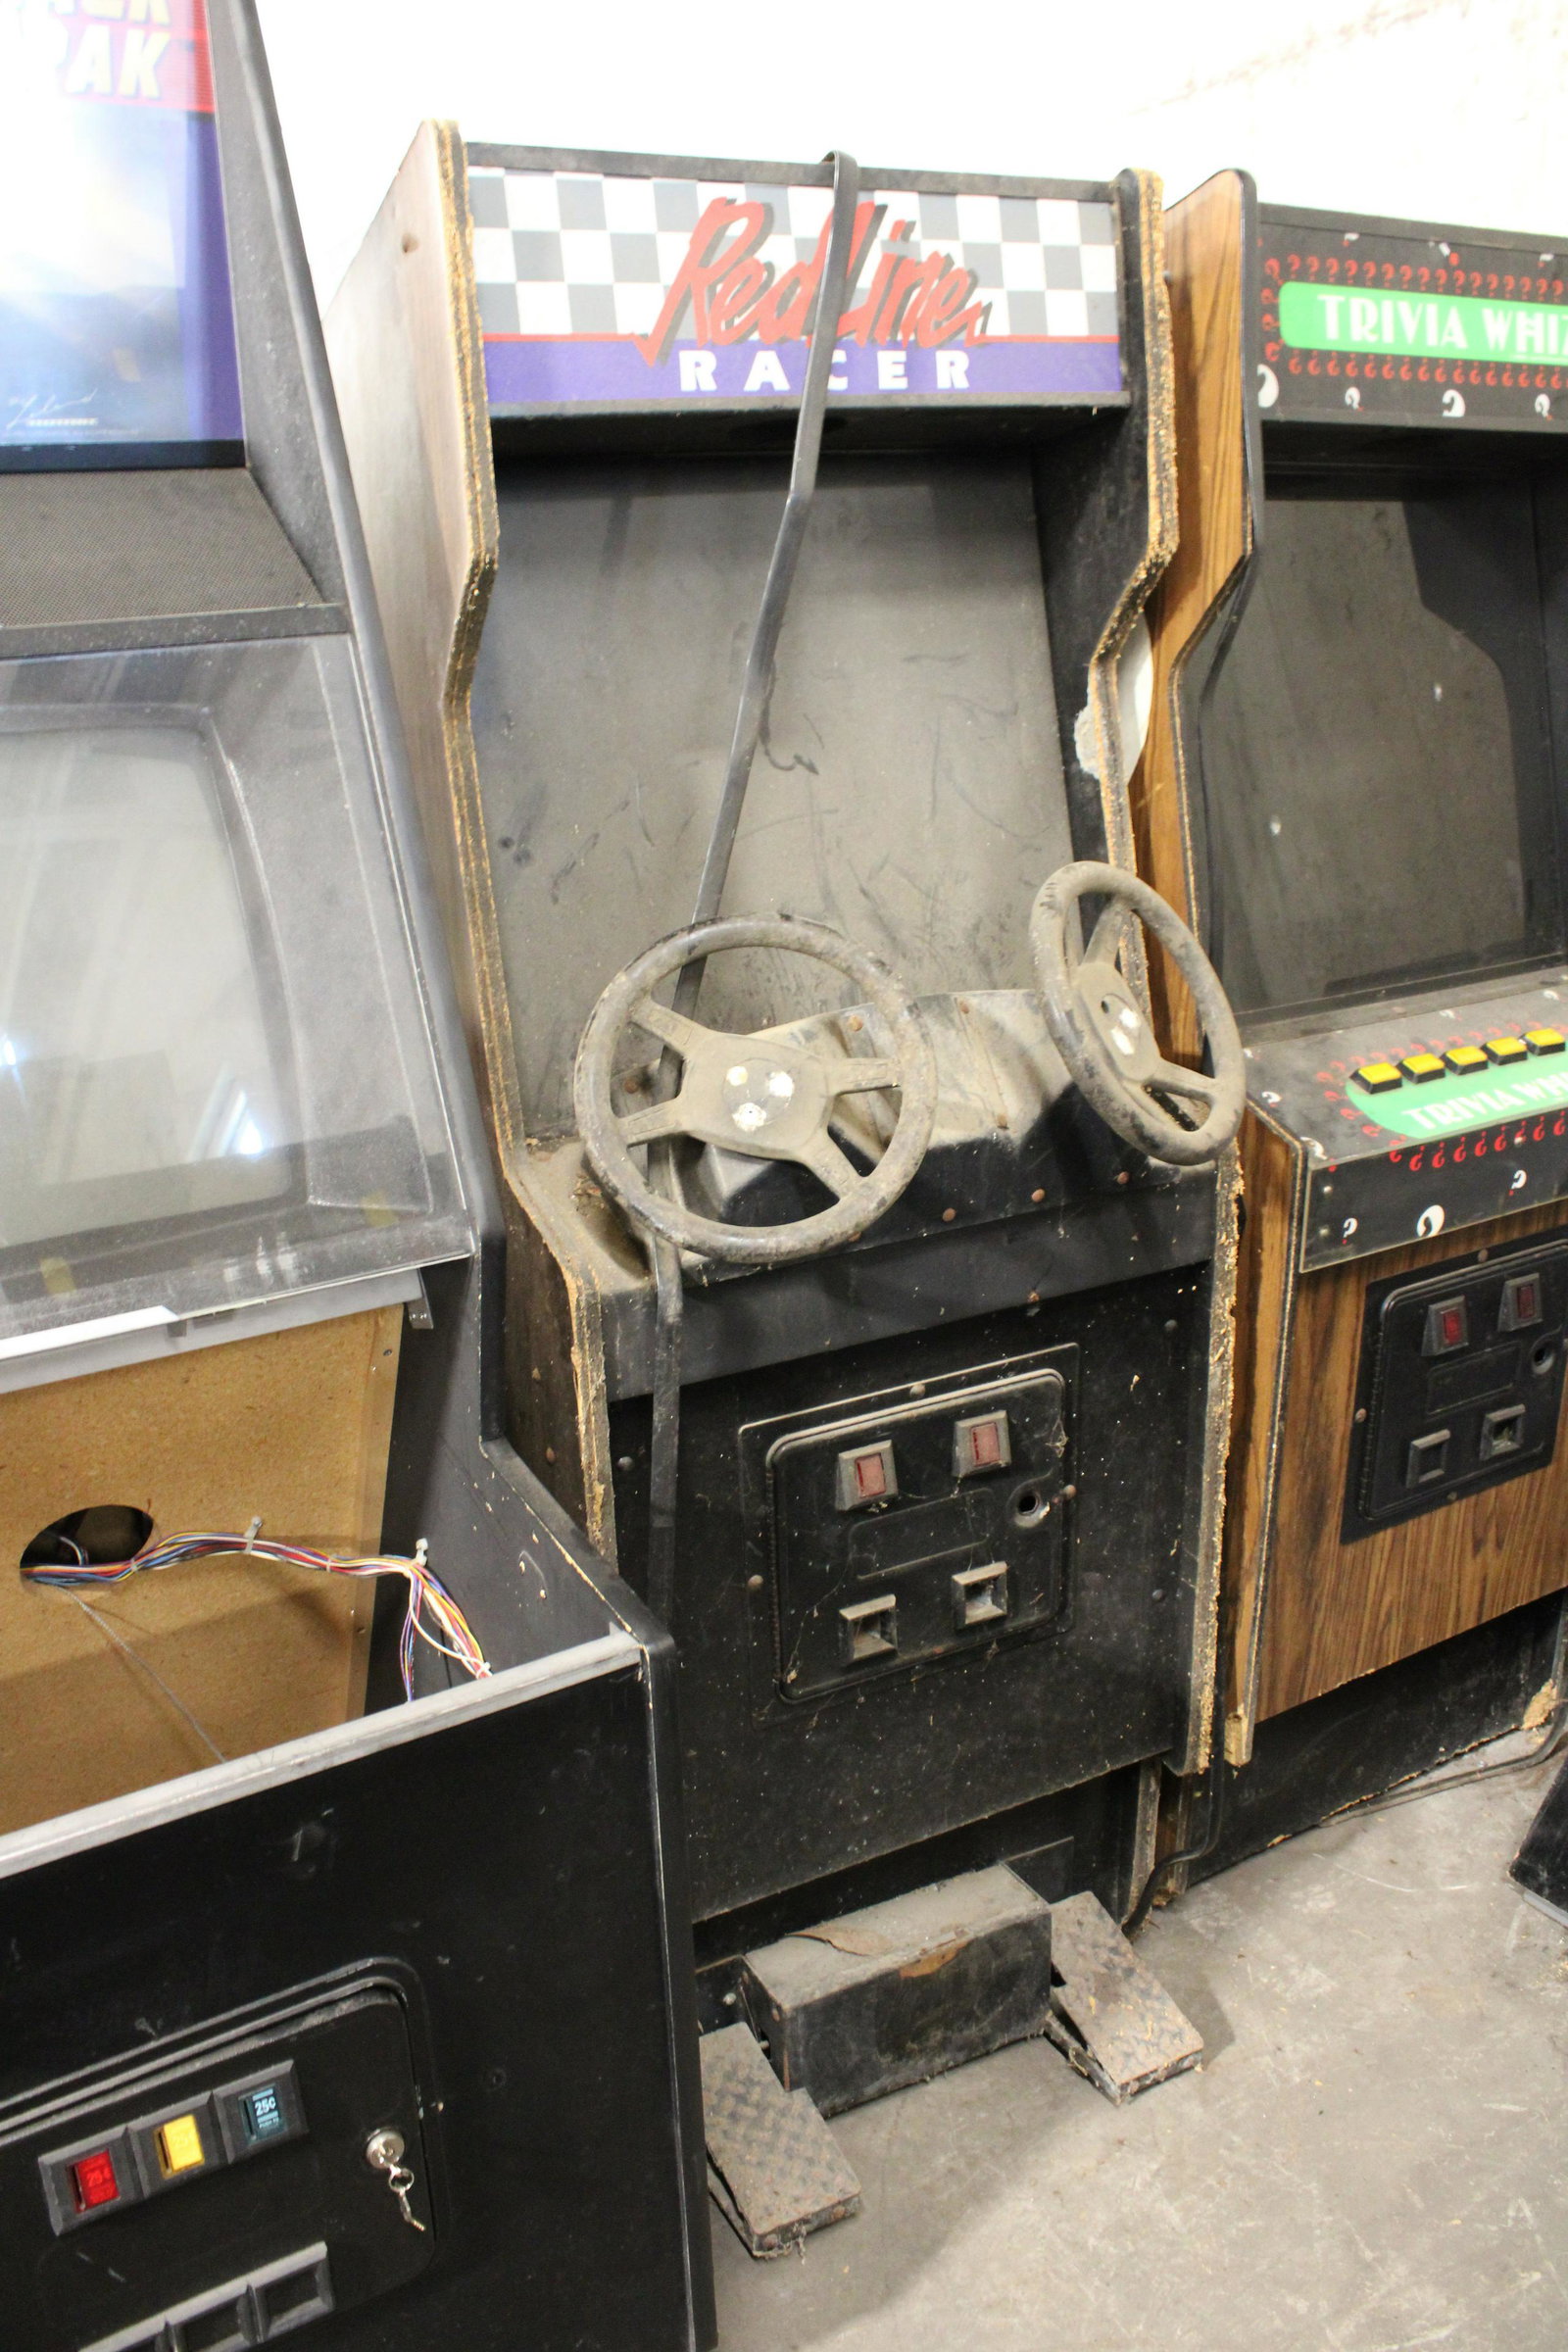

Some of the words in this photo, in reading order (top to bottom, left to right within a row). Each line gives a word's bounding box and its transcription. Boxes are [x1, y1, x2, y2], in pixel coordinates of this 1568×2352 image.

[1317, 294, 1468, 349] TRIVIA
[1481, 308, 1568, 356] WHI
[678, 347, 970, 392] RACER
[1400, 1088, 1526, 1130] TRIVIA
